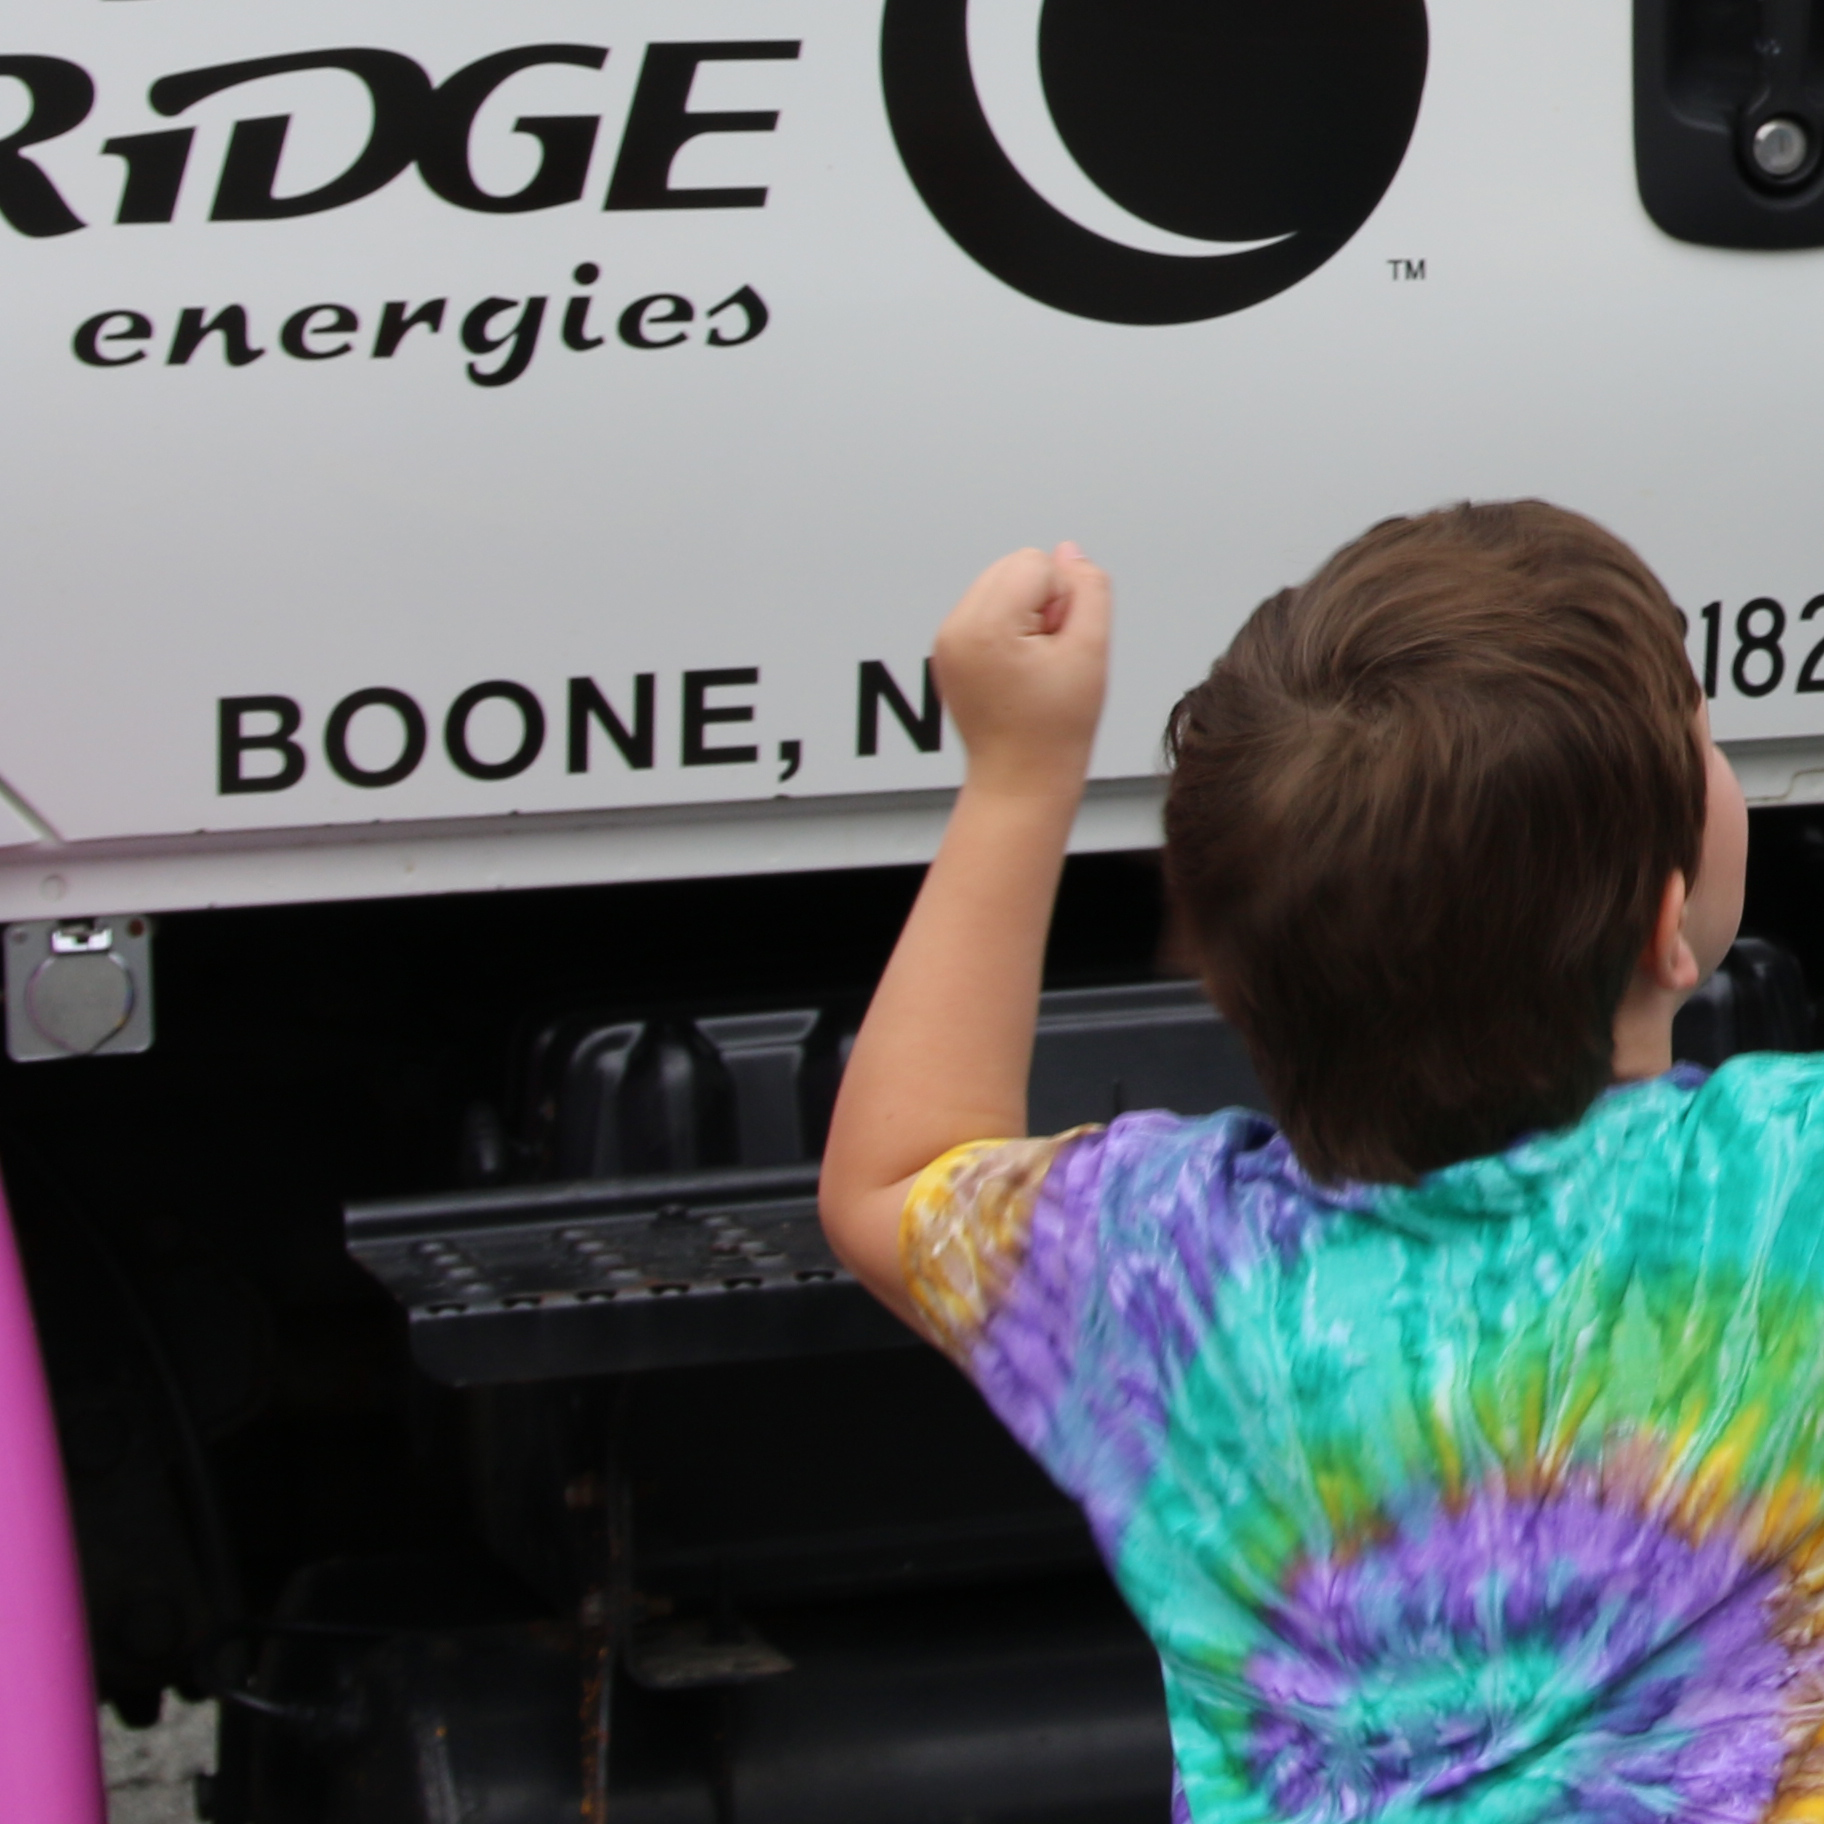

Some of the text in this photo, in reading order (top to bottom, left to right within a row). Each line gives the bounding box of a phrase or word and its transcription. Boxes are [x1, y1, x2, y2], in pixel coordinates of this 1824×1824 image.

[70, 262, 771, 387] energies
[1386, 258, 1426, 281] TM
[217, 667, 803, 796] BOONE,
